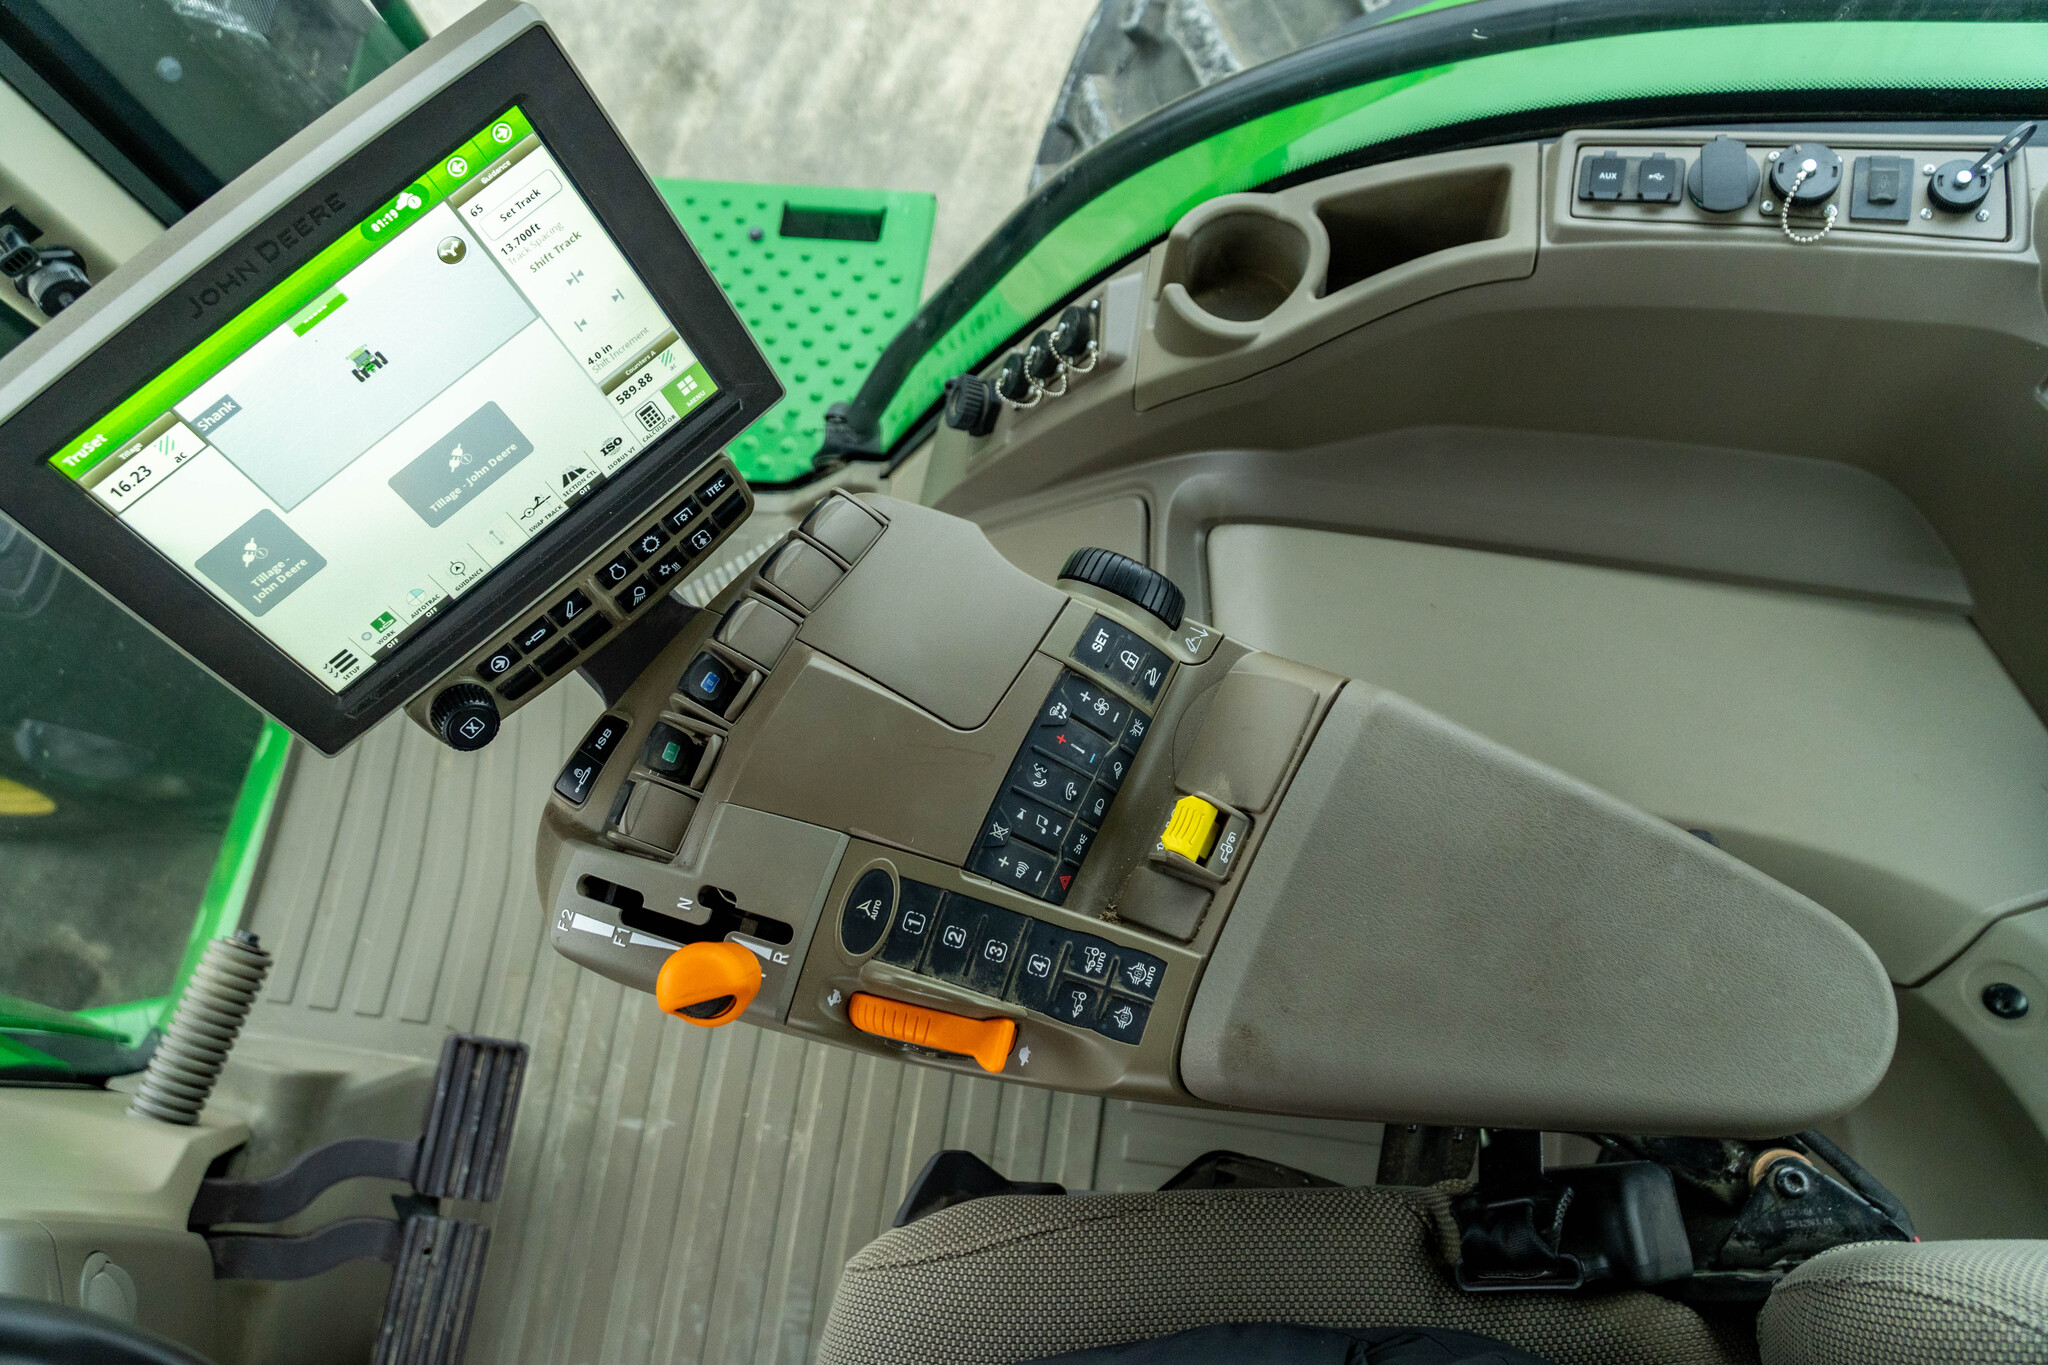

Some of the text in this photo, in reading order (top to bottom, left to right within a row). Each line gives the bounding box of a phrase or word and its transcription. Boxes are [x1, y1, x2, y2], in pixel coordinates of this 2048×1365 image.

[481, 160, 511, 184] Guidance
[1599, 171, 1617, 181] AUX
[470, 204, 484, 217] 65
[500, 188, 541, 222] Set Track
[371, 209, 399, 233] 01:19
[501, 223, 541, 256] 13.700ft
[508, 222, 564, 265] Track Spacing
[189, 192, 347, 320] JOHN DEERE
[530, 231, 582, 273] Shift Track
[587, 344, 612, 365] 4.0 in
[592, 327, 649, 373] Shift Increment
[625, 350, 656, 375] Counters A
[616, 373, 653, 405] 589.88
[686, 390, 706, 407] MENU
[197, 400, 236, 432] Shank
[643, 415, 676, 442] CALCULATOR
[62, 433, 108, 467] TruSet
[119, 442, 143, 460] Tillage
[175, 451, 187, 464] ac
[600, 437, 622, 456] ISO
[607, 446, 636, 470] ISOBUS VT
[110, 465, 152, 498] 16.23
[430, 486, 462, 513] Tillage
[465, 465, 490, 488] John
[488, 443, 517, 468] Deere
[563, 469, 597, 497] SECTION CTL
[529, 505, 563, 532] SWAP TRACK
[250, 561, 283, 588] Tillage
[253, 557, 308, 603] John Deere
[455, 568, 484, 592] GUIDANCE
[411, 594, 440, 619] AUTOTRAC
[377, 630, 396, 645] WORK
[1092, 629, 1109, 653] SET
[343, 666, 361, 681] SETUP
[595, 728, 612, 750] ISB
[677, 898, 694, 910] N
[870, 899, 883, 920] AUTO
[557, 908, 574, 932] F2
[613, 928, 632, 948] F1
[773, 952, 790, 965] R
[1095, 951, 1107, 974] AUTO
[1145, 965, 1157, 988] AUTO
